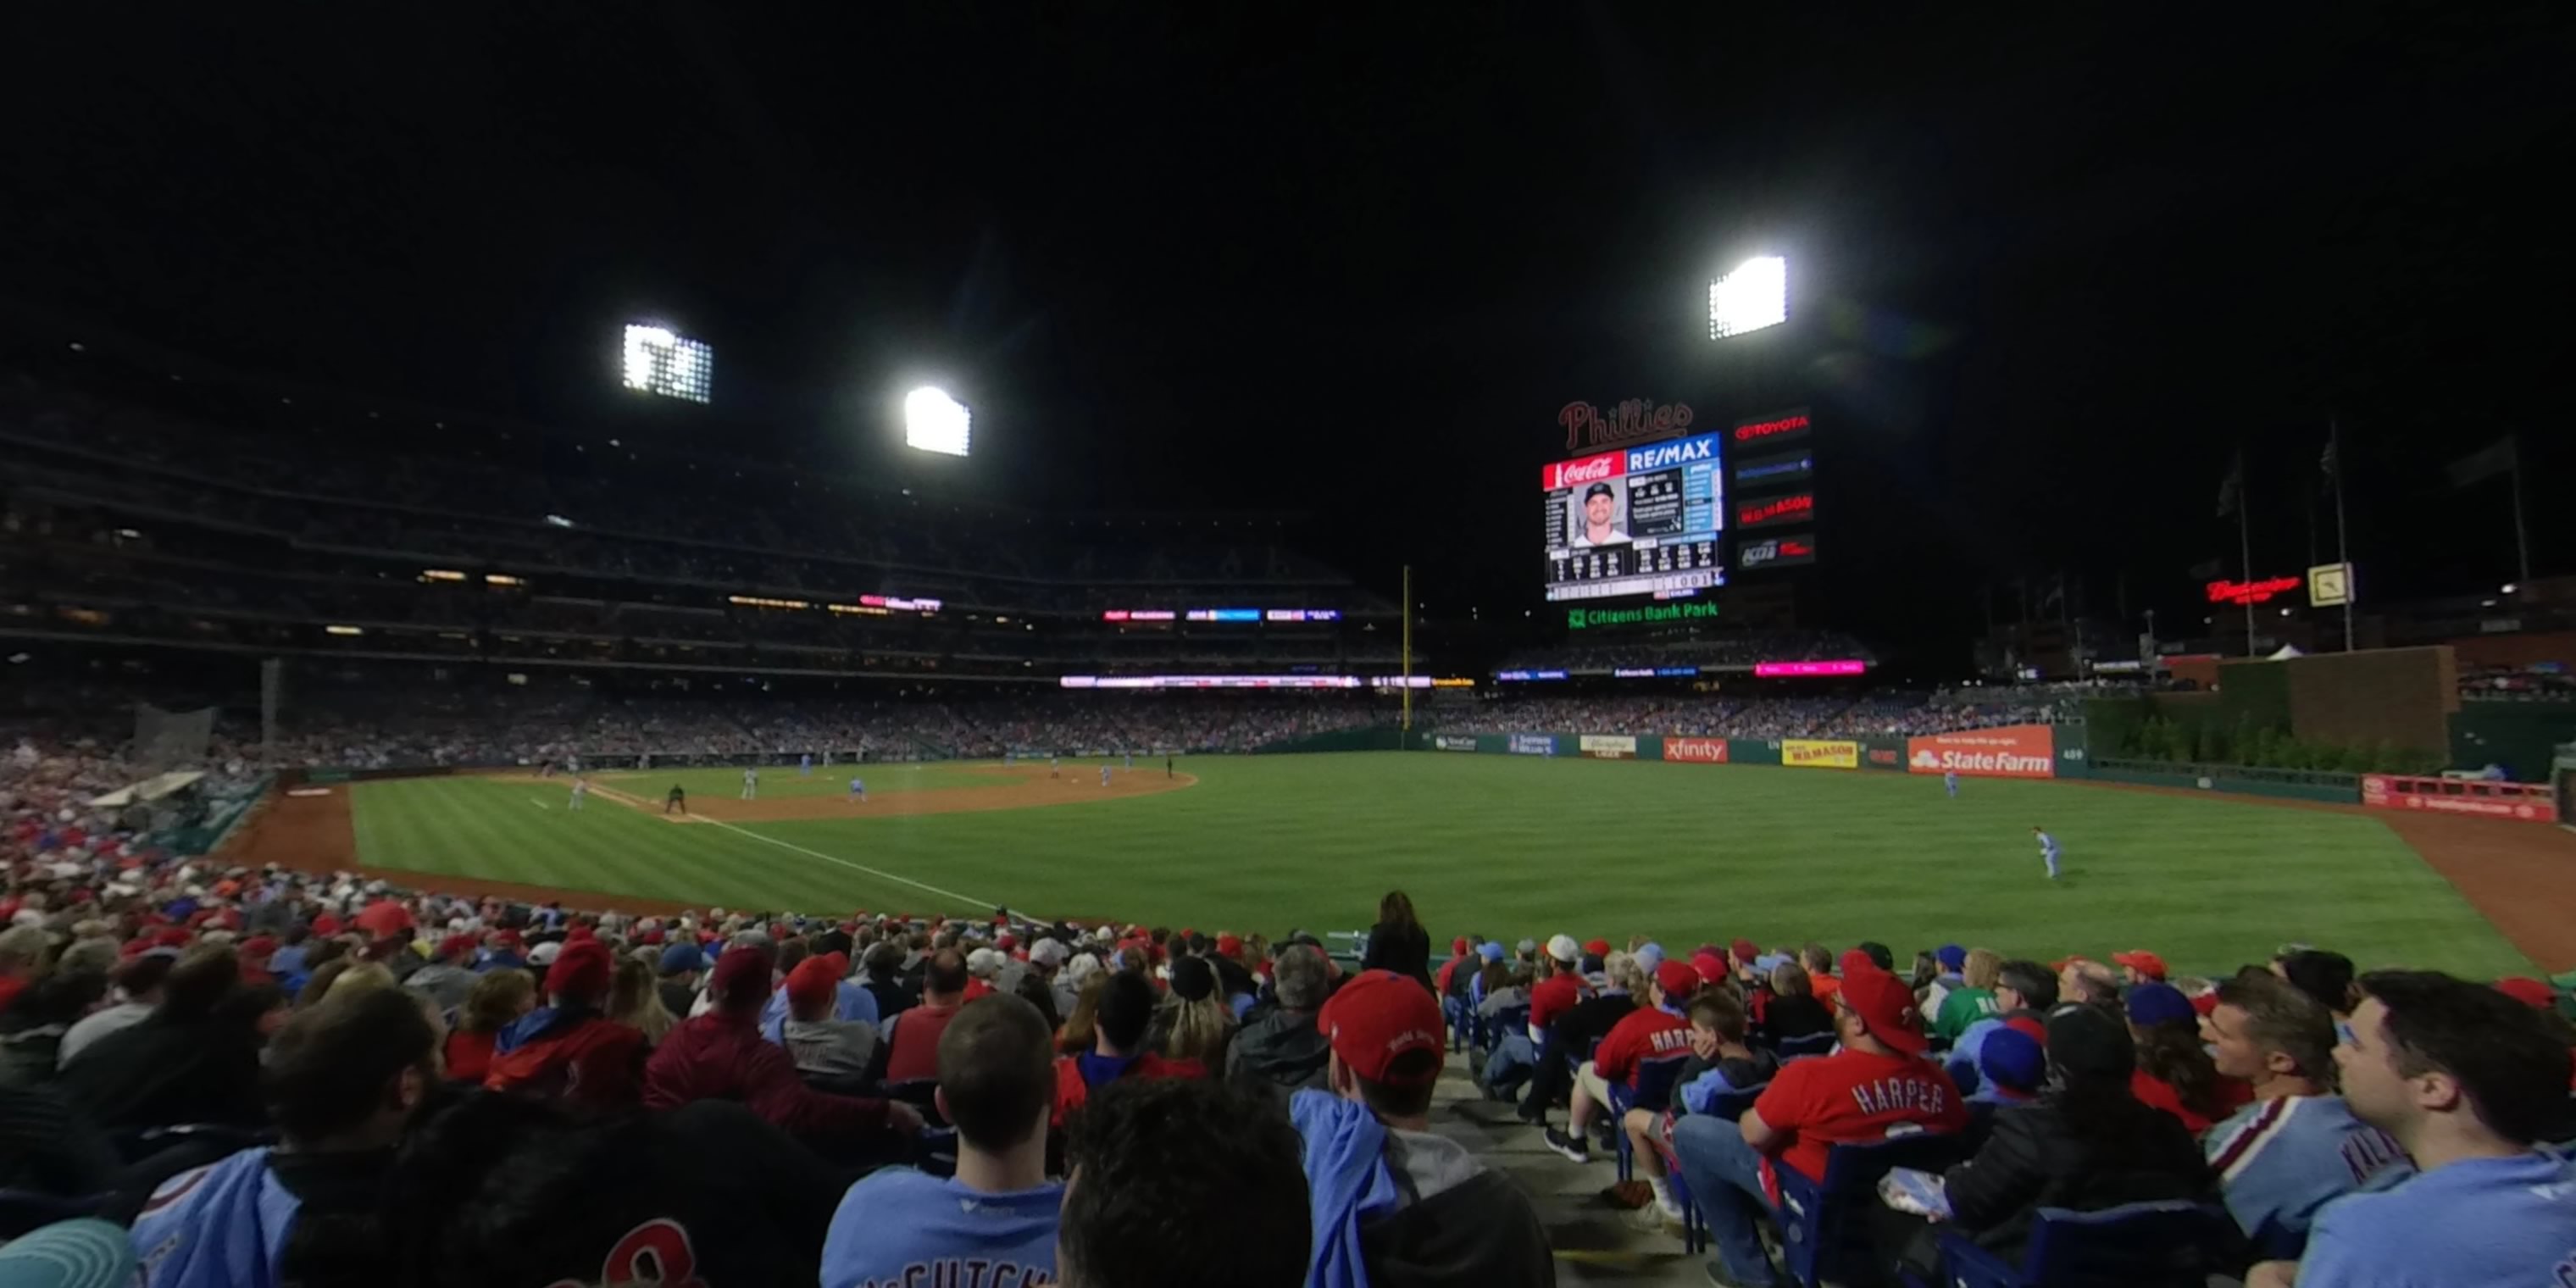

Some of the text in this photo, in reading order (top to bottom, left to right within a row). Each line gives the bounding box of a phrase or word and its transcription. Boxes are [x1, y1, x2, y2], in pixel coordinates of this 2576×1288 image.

[1558, 398, 1693, 450] Phillies
[1755, 416, 1808, 435] TOYOTA
[1630, 440, 1710, 470] RE/MAX
[1588, 600, 1718, 624] Citizens Bank Park
[1667, 739, 1722, 760] xfinity
[1851, 1077, 1943, 1115] HARPER
